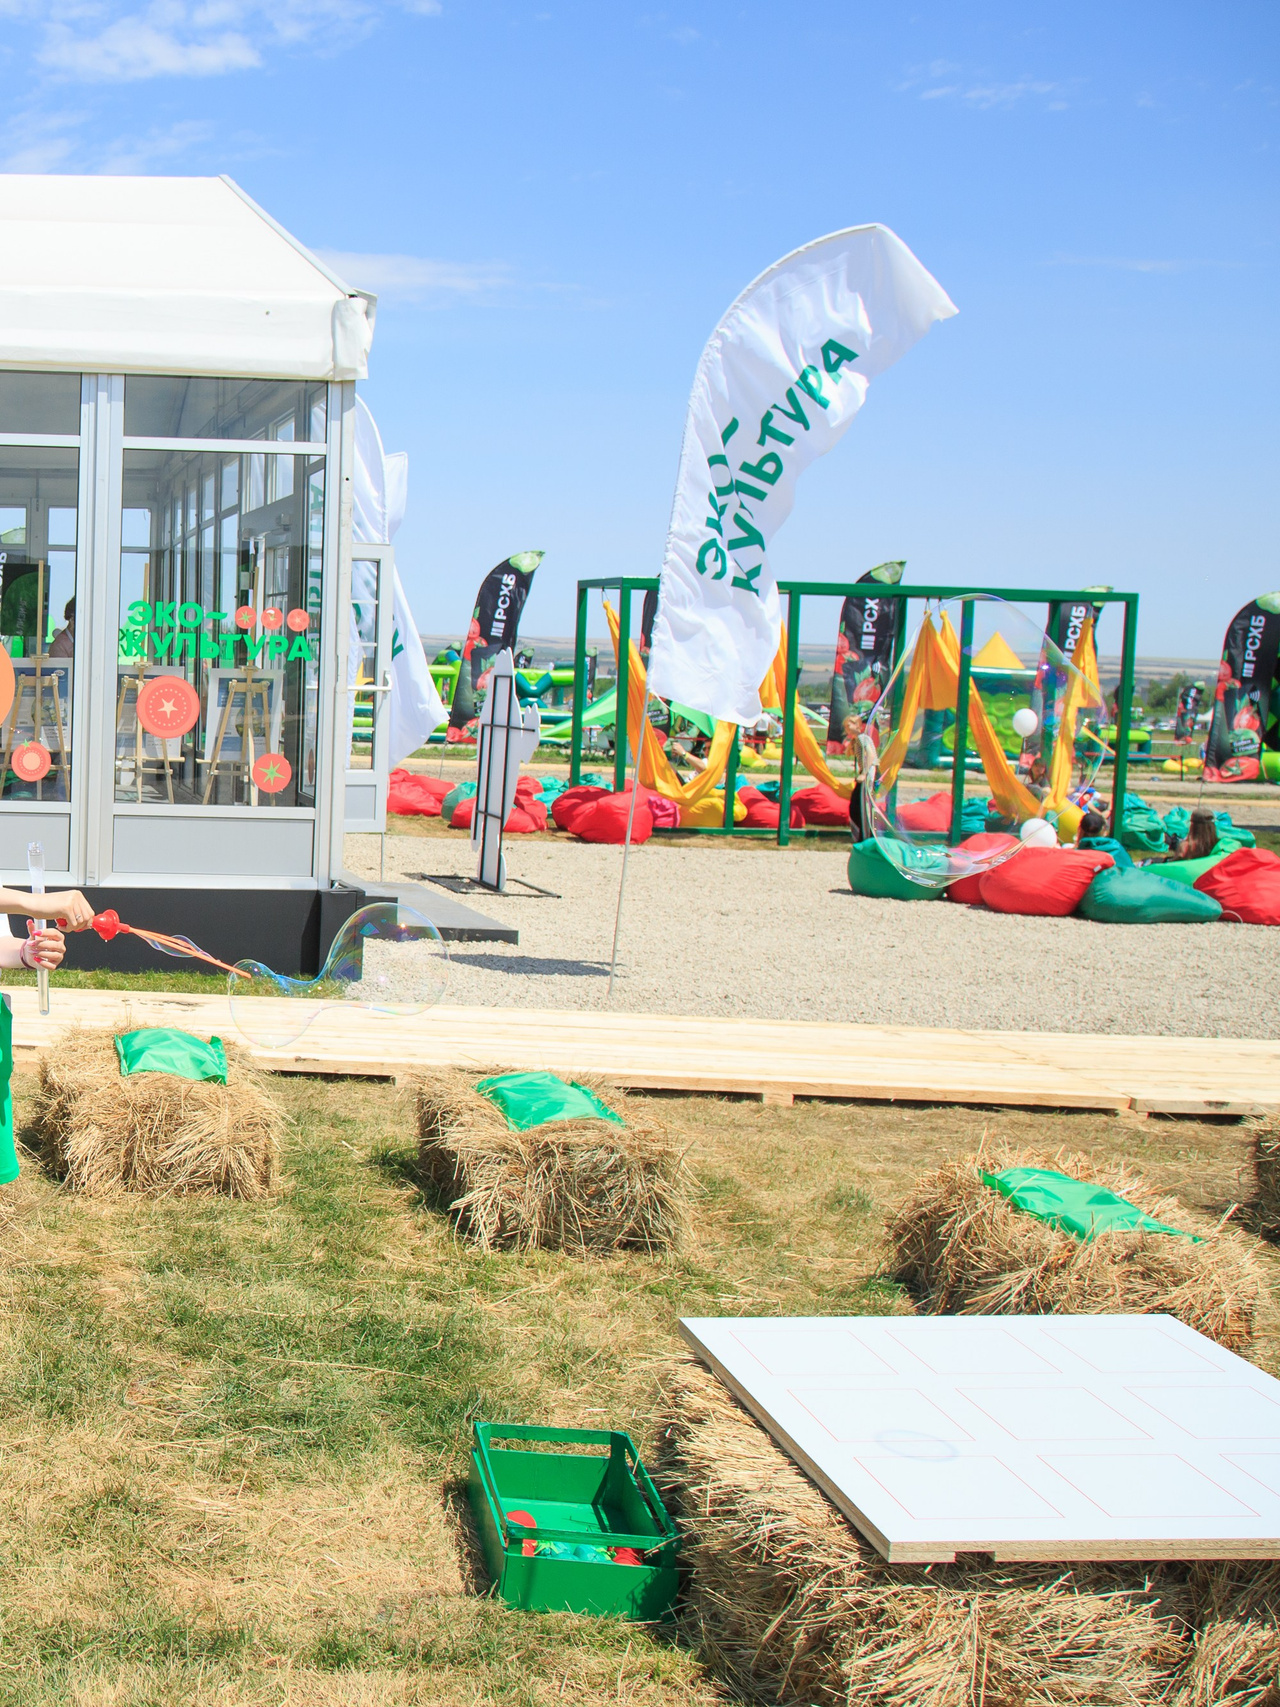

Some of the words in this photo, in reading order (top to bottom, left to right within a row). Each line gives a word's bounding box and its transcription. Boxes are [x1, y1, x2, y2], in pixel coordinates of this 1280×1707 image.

[726, 338, 860, 598] КУЛЬТУРА
[493, 573, 517, 621] РСХБ
[126, 632, 313, 662] КУЛЬТУРА
[1064, 605, 1087, 653] РСХБ
[1243, 615, 1266, 662] РСХБ
